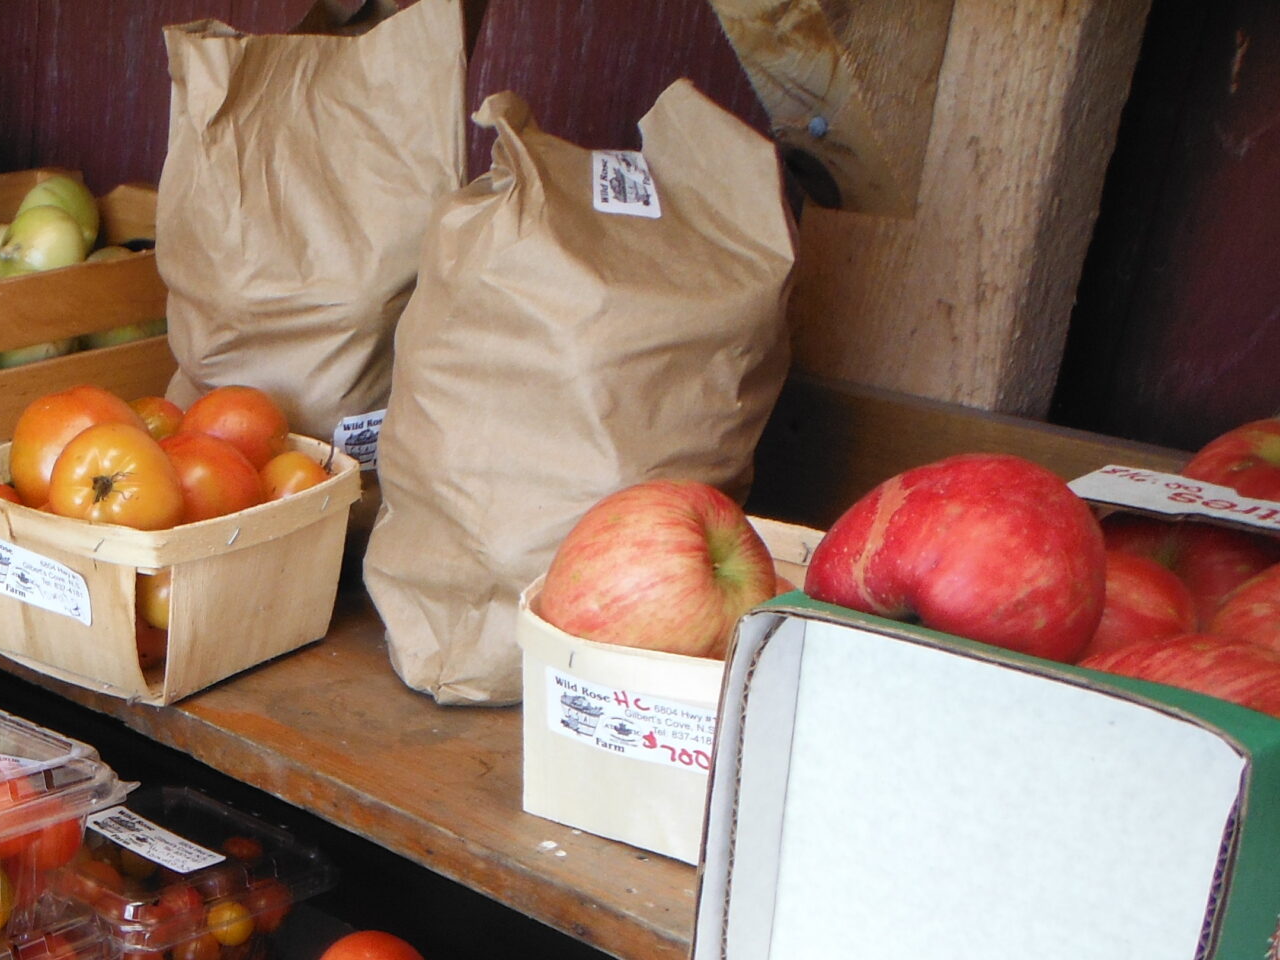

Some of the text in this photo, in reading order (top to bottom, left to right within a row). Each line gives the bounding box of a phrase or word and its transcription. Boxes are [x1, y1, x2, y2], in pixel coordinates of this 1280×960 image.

[5, 583, 27, 598] Farm
[555, 676, 578, 693] Wild
[581, 686, 611, 703] Rose
[624, 708, 662, 724] Gilbert's
[654, 704, 678, 716] 6804
[681, 710, 703, 722] Hwy
[596, 737, 625, 753] Farm
[671, 730, 713, 746] 837-418
